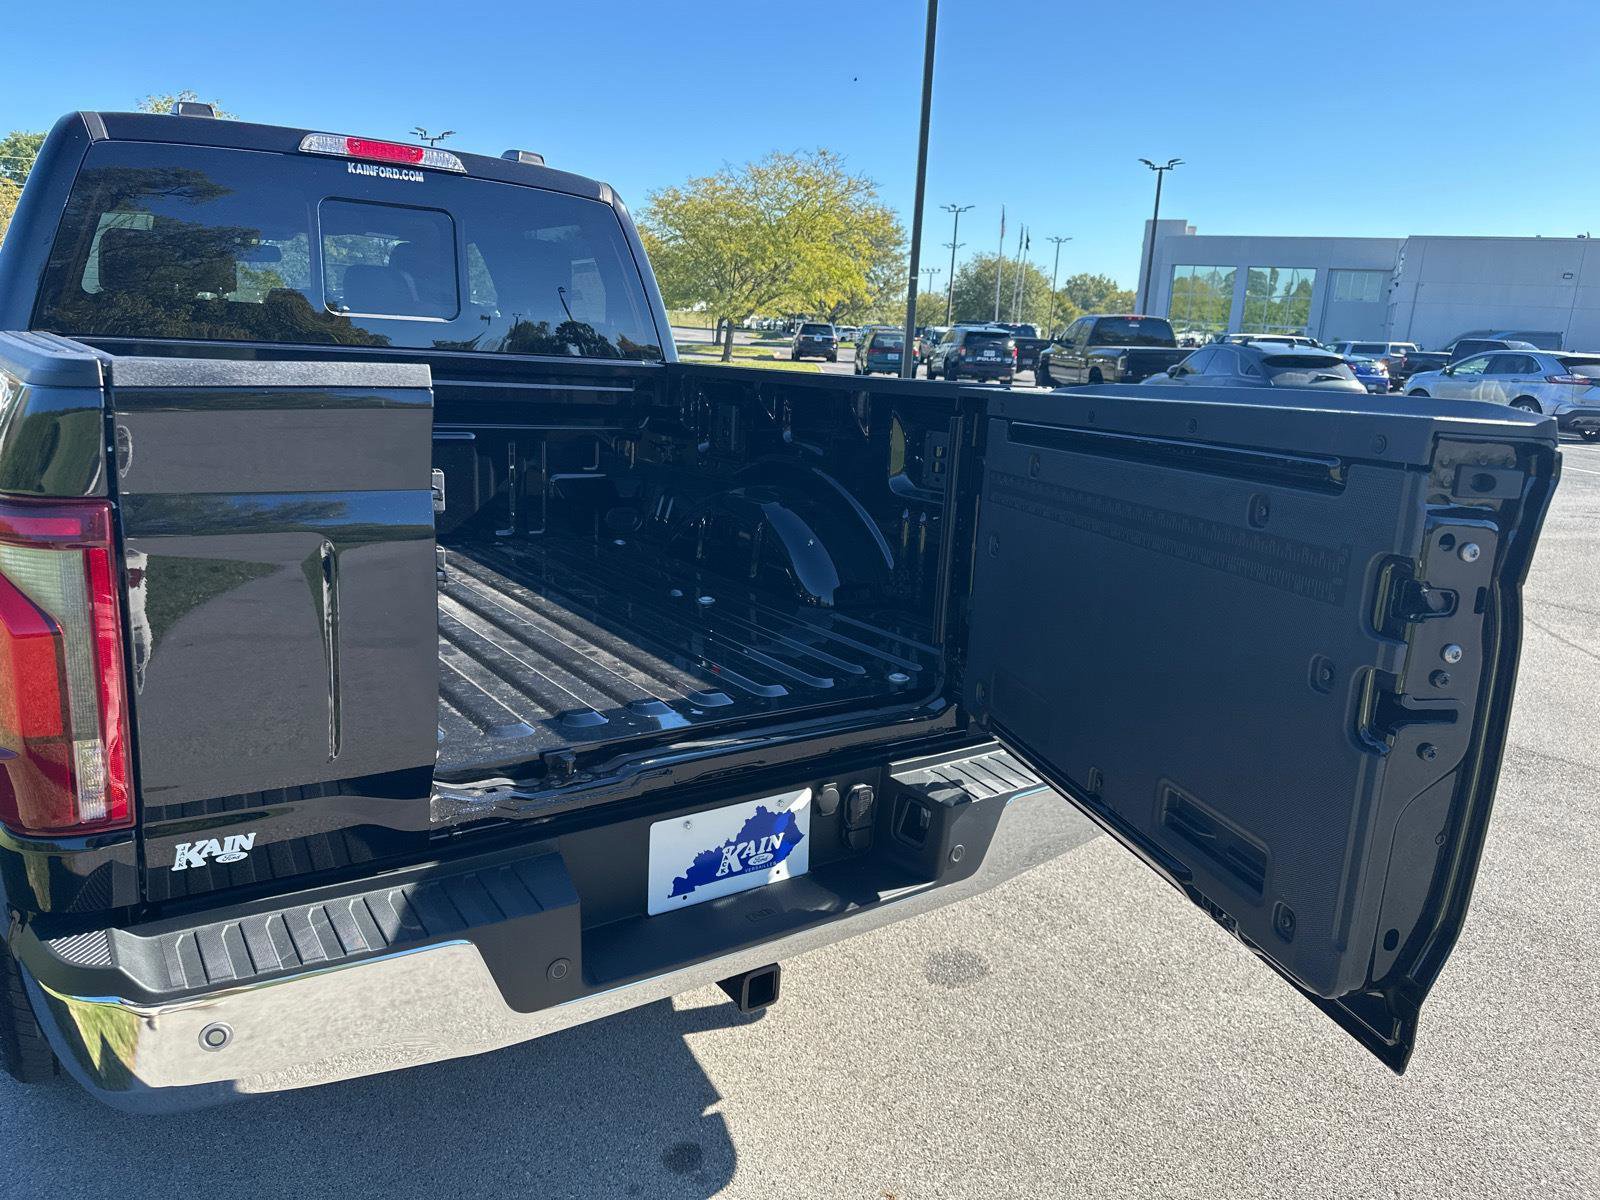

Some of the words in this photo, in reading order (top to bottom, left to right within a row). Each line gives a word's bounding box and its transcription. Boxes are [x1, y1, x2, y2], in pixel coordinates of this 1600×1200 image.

[347, 162, 425, 183] KAINFORD.COM
[171, 832, 257, 872] KAIN
[178, 845, 187, 868] JACK
[716, 832, 786, 877] KAIN
[720, 848, 730, 874] JACK
